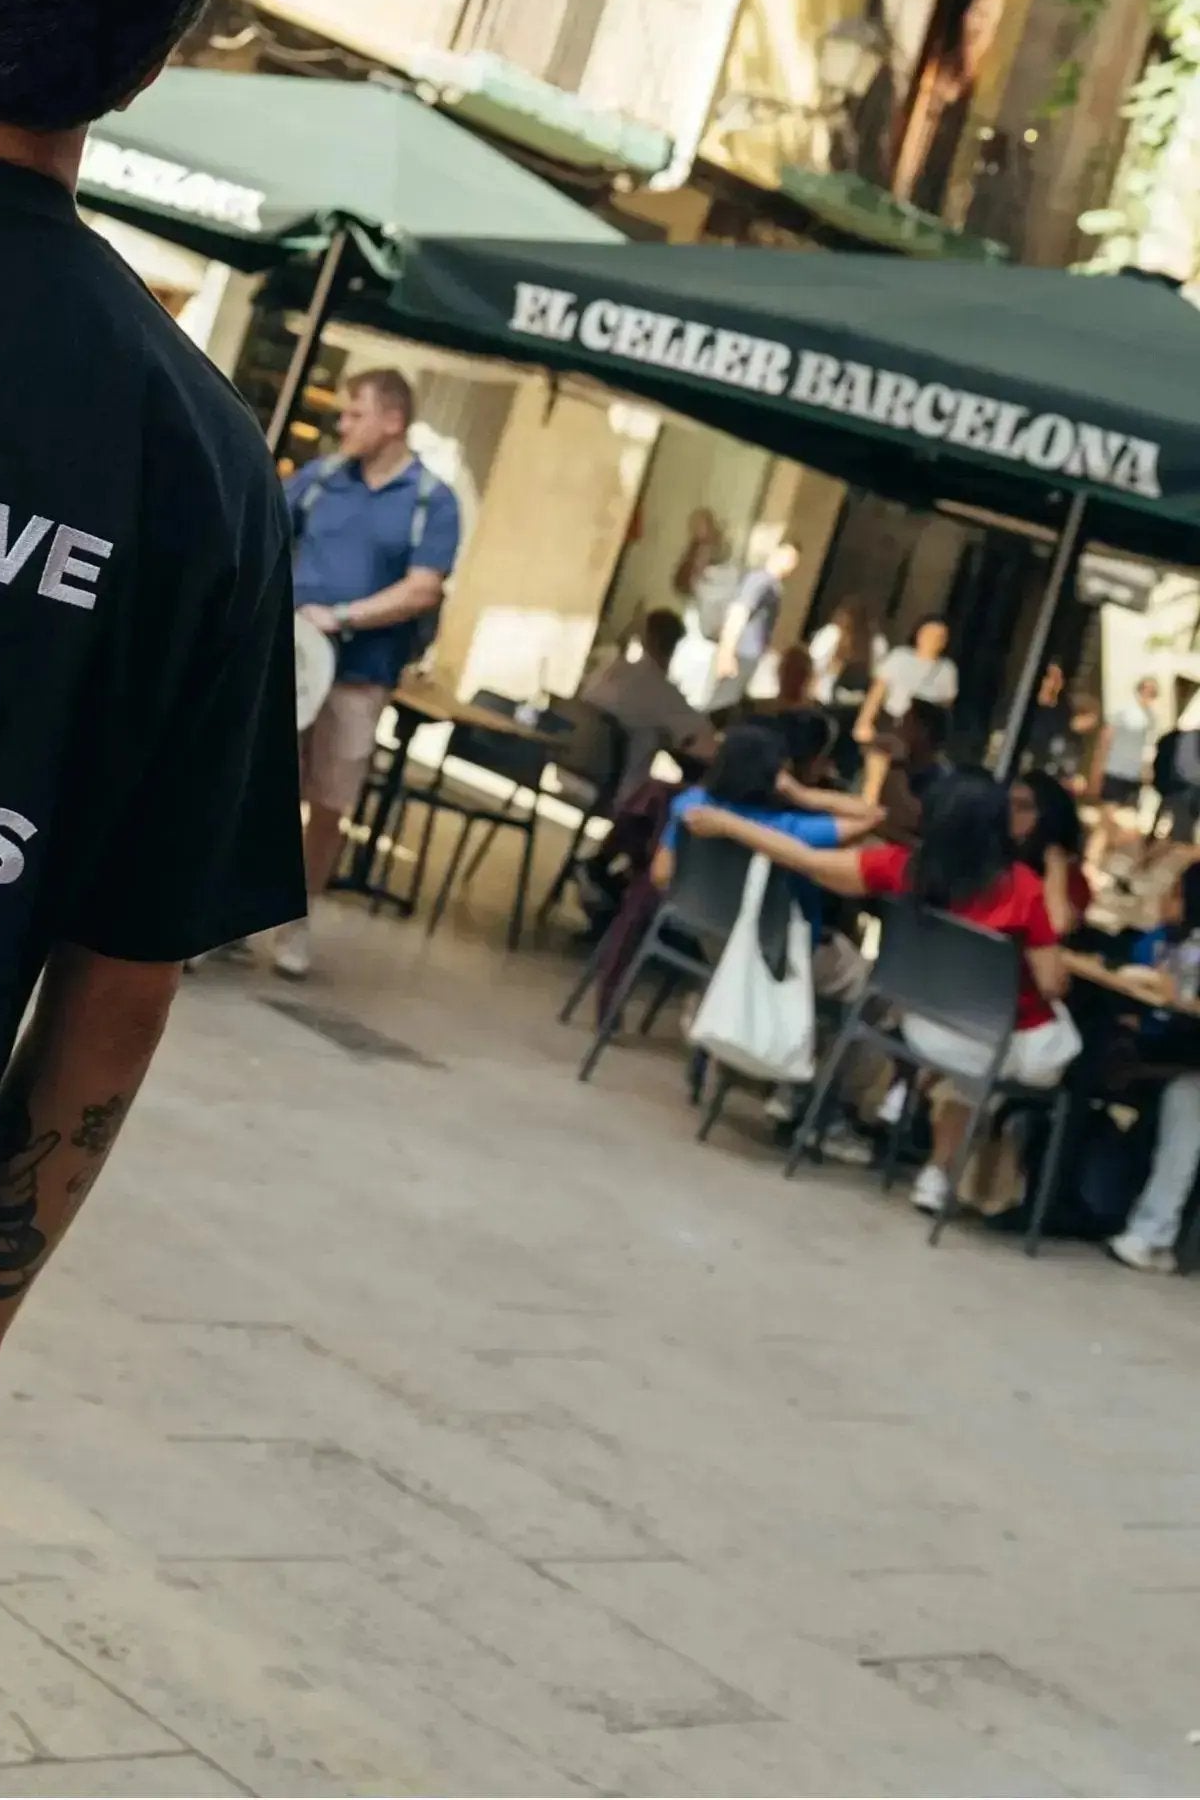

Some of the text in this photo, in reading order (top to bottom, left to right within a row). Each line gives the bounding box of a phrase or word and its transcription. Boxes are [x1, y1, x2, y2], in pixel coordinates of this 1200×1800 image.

[509, 282, 1161, 498] EL CELLER BARCELONA
